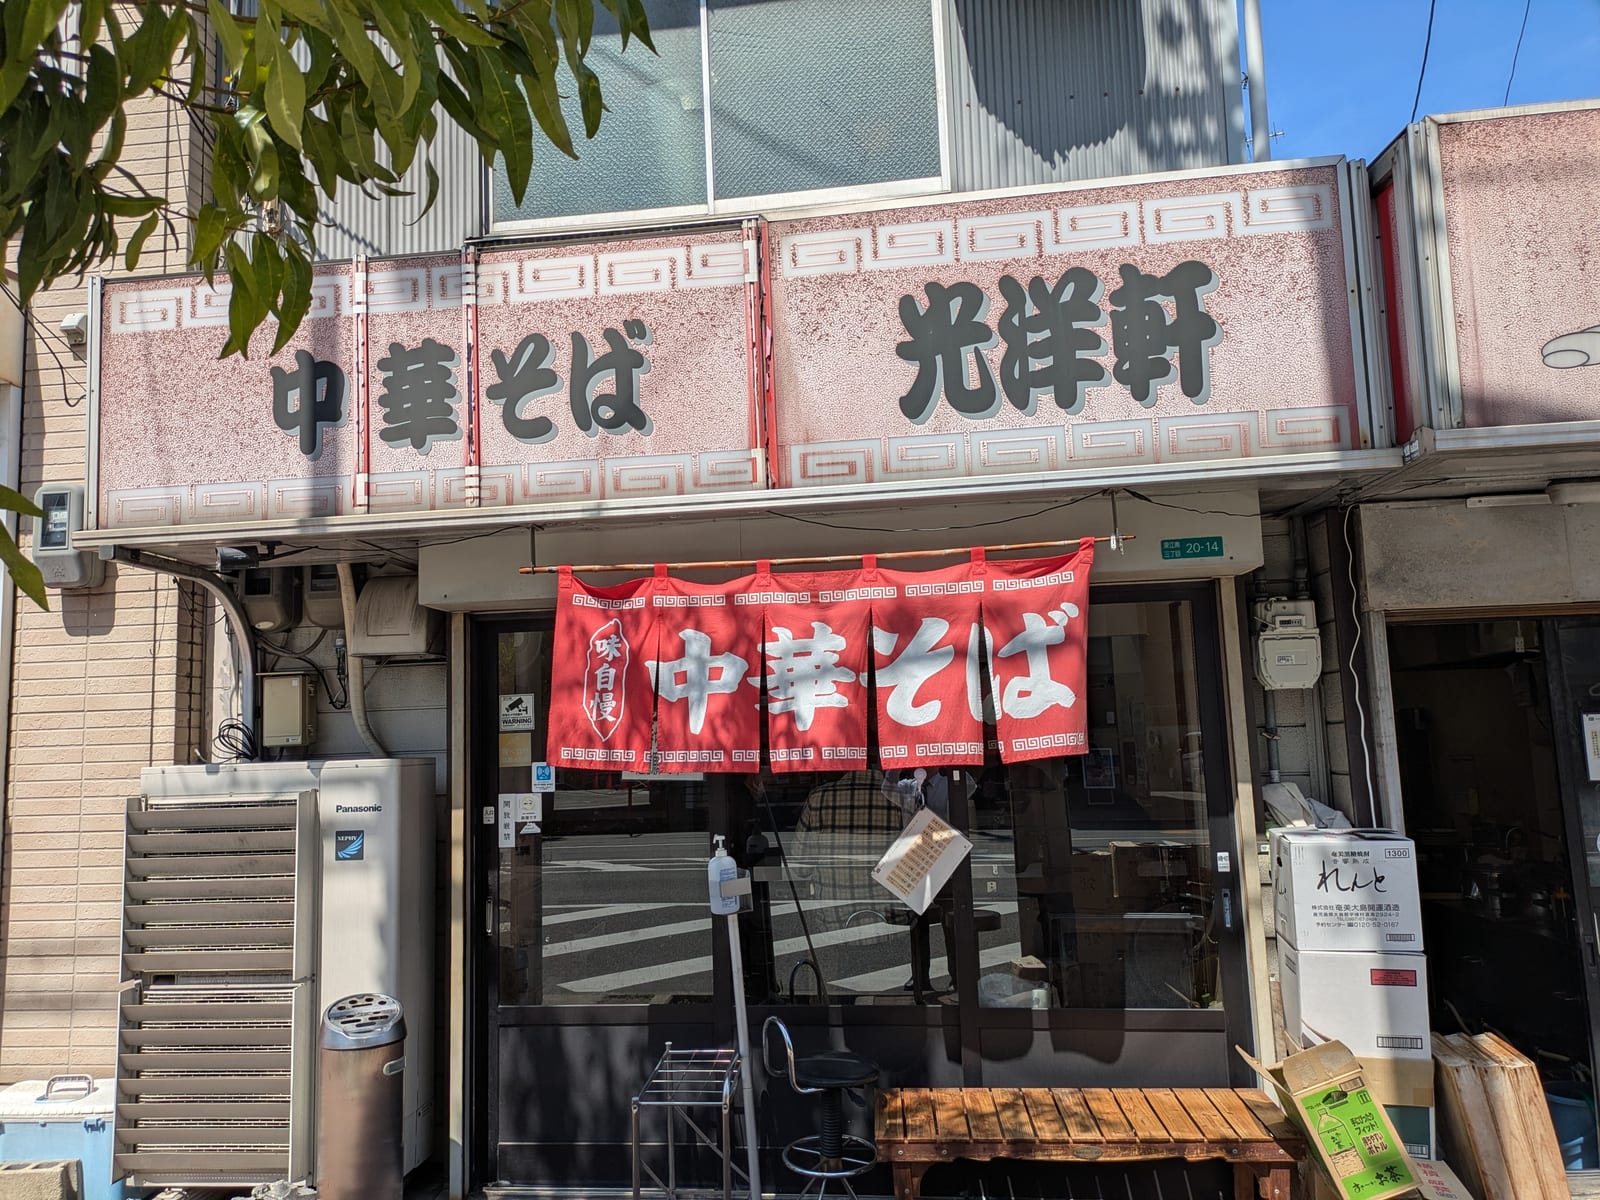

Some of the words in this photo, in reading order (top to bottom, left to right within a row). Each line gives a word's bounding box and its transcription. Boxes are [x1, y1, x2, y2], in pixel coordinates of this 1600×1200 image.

[895, 260, 1223, 424] 光洋軒
[270, 319, 653, 461] 中華そば
[1185, 541, 1219, 553] 20-14
[589, 634, 623, 724] 味自慢
[644, 602, 1079, 736] 中華そば
[501, 717, 532, 725] WARNING
[336, 803, 382, 813] Panasonic
[1317, 860, 1387, 892] れんと
